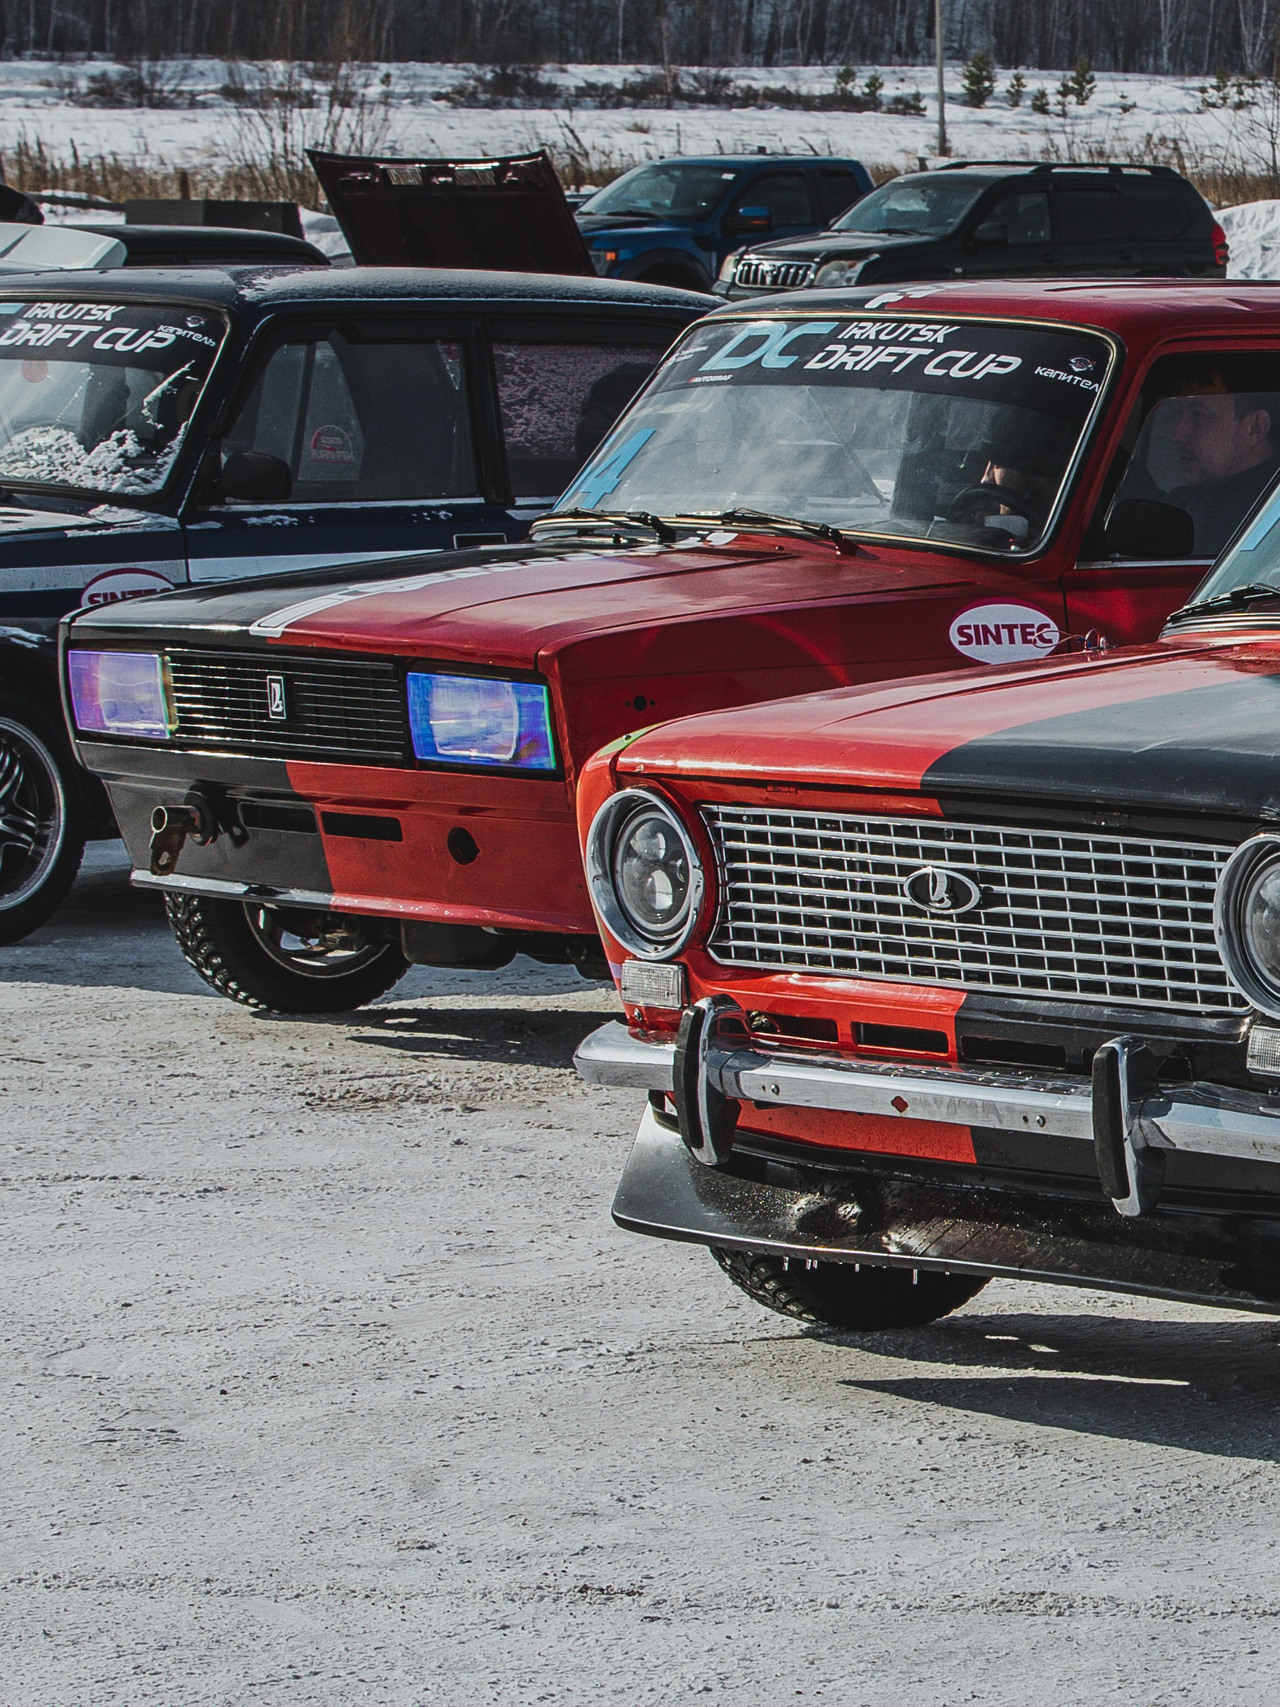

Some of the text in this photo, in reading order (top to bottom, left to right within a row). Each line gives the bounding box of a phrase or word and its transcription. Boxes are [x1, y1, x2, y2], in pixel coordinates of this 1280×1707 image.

[23, 303, 125, 321] IRKUTSK
[0, 323, 176, 353] DRIFT CUP
[837, 322, 961, 343] IRKUTSK
[698, 321, 839, 371] DC
[803, 344, 1022, 380] DRIFT CUP
[1034, 366, 1100, 392] капител
[956, 623, 1053, 646] SINTEC
